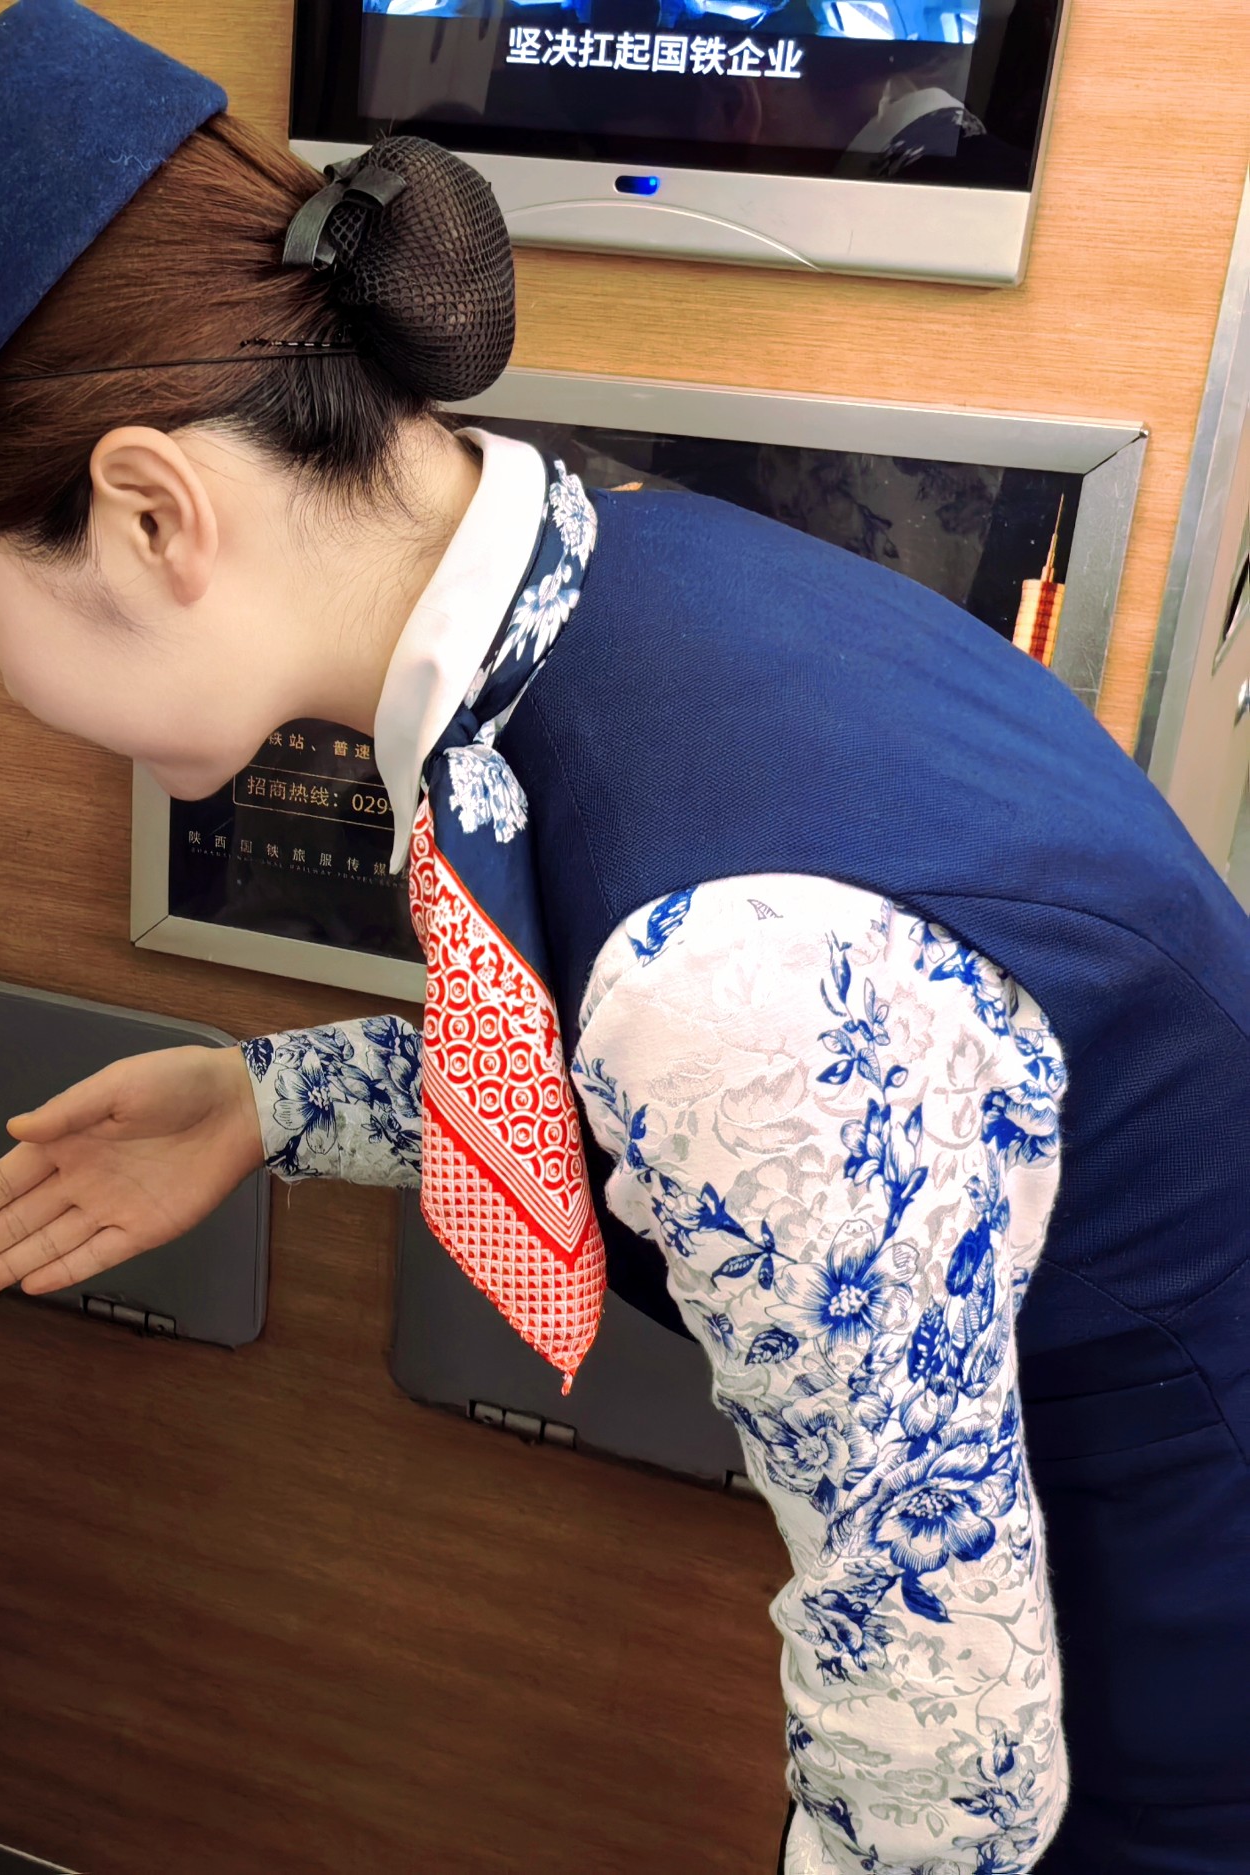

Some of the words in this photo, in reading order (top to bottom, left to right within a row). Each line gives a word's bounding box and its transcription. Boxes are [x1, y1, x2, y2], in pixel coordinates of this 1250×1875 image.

[506, 27, 803, 79] 坚决扛起国铁企业
